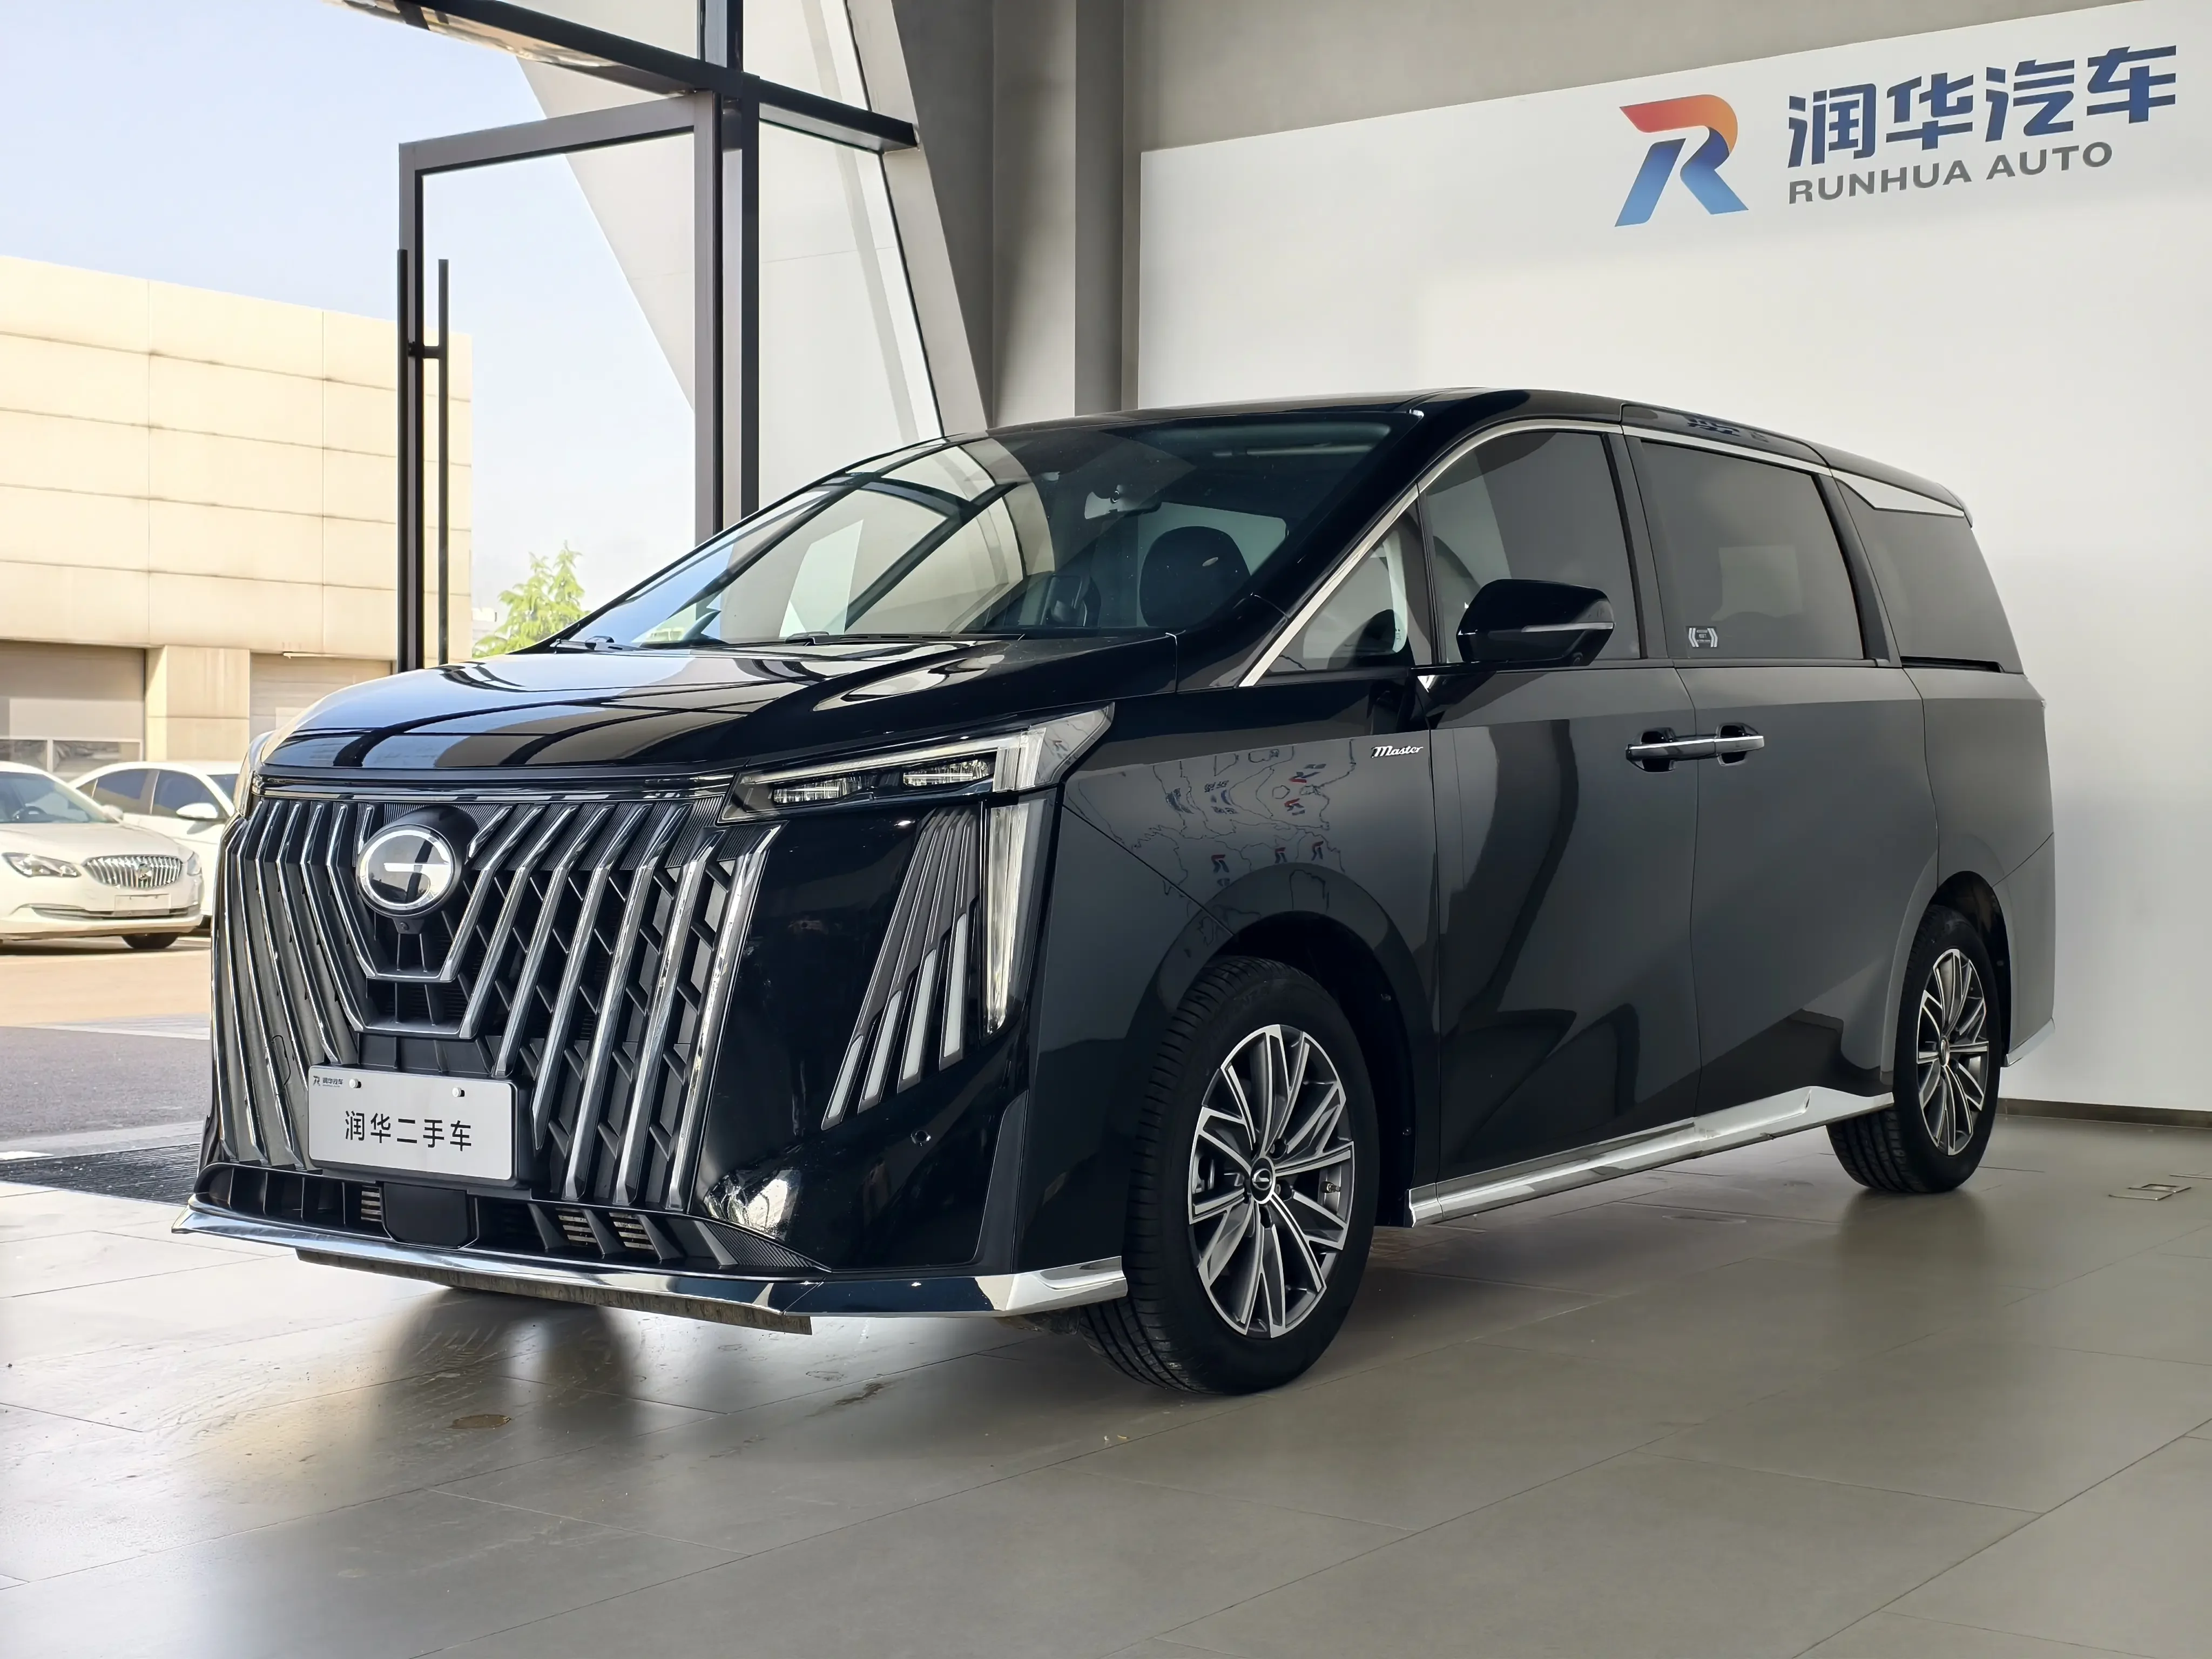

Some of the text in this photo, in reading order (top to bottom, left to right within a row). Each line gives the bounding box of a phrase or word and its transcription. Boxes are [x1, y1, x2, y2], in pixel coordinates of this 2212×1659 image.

[1787, 45, 2177, 168] 润华汽车
[1789, 141, 2113, 204] RUNHUA AUTO
[1371, 746, 1424, 758] Master
[345, 1110, 472, 1151] 润华二手车
